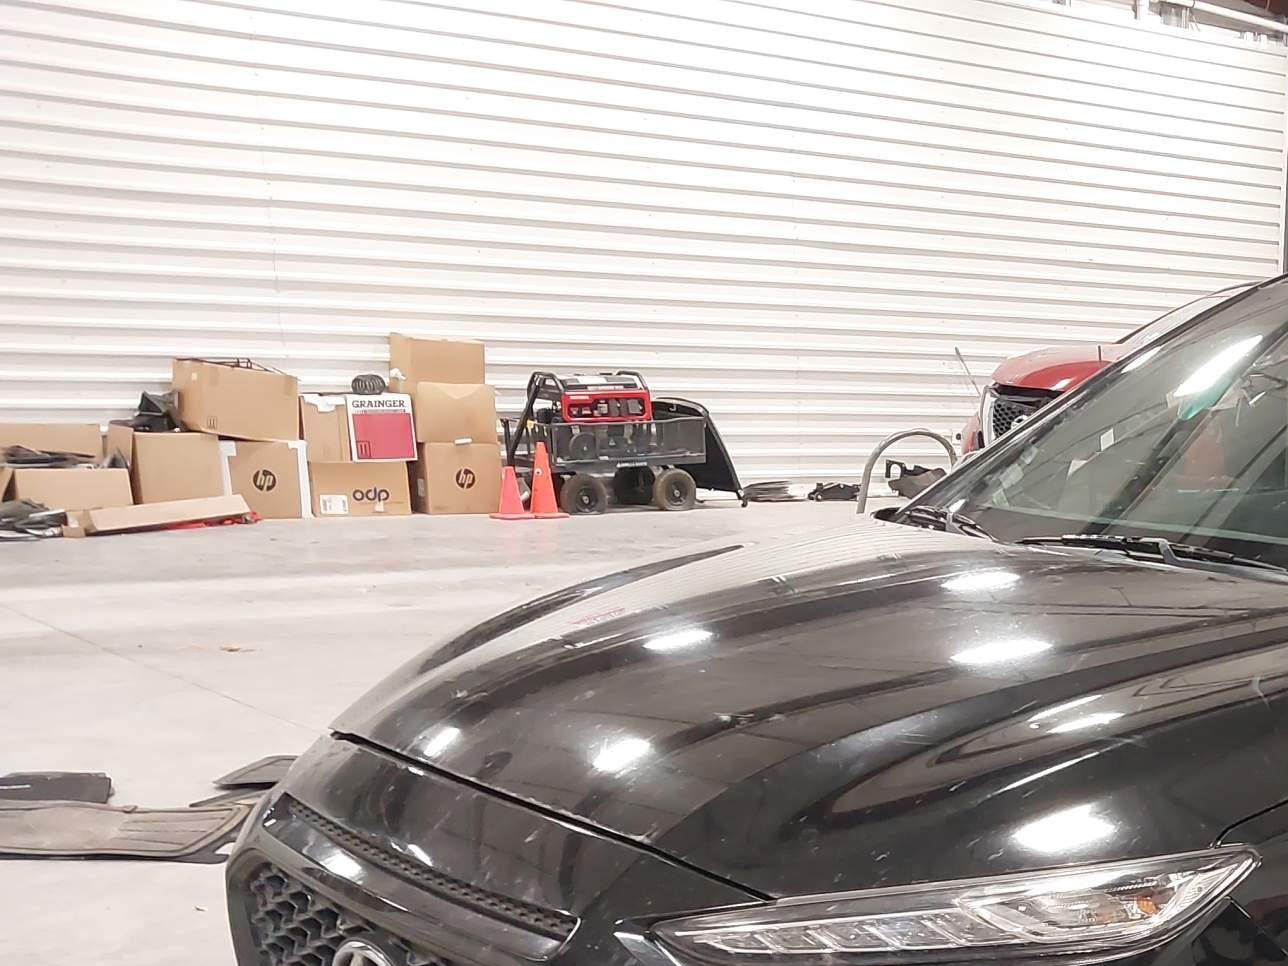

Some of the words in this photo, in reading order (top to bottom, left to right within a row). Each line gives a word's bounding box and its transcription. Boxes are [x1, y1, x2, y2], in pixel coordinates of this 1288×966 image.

[352, 399, 405, 409] GRAINGER
[255, 469, 275, 492] hp
[456, 468, 475, 489] hp
[352, 486, 390, 503] odp
